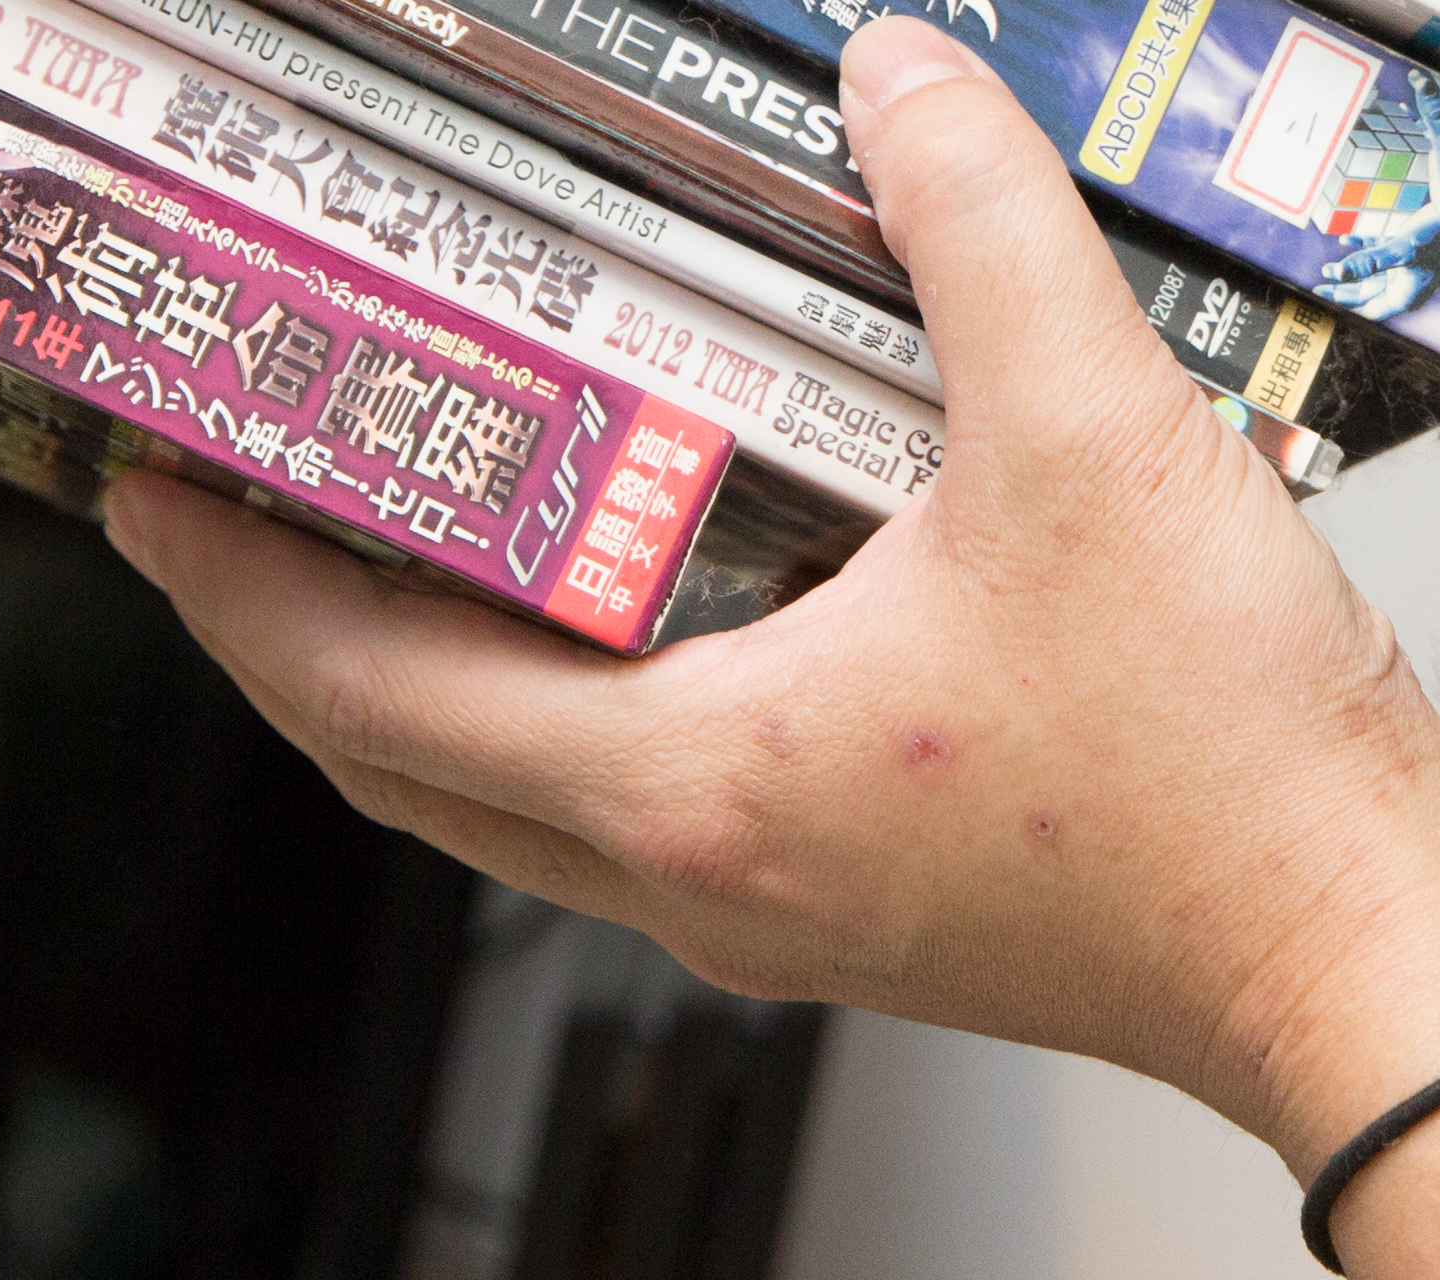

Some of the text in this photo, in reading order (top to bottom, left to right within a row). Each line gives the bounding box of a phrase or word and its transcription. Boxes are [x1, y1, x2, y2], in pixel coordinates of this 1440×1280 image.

[1, 14, 148, 121] TMA
[279, 50, 420, 130] present
[416, 108, 486, 161] The
[485, 137, 581, 203] Dove
[580, 183, 671, 245] Artist
[146, 70, 605, 338] 魔術大會紀念光碟
[600, 300, 785, 418] 2012 TMA
[793, 288, 925, 368] 鴿劇魅影
[1183, 275, 1234, 353] DVD
[1219, 301, 1253, 359] VIDEO
[1256, 300, 1325, 412] 出租專用
[768, 401, 935, 500] Special F
[782, 370, 951, 471] Magic Co
[507, 387, 609, 588] Cyril
[565, 421, 671, 602] 日語發音
[604, 443, 703, 617] 中文字幕
